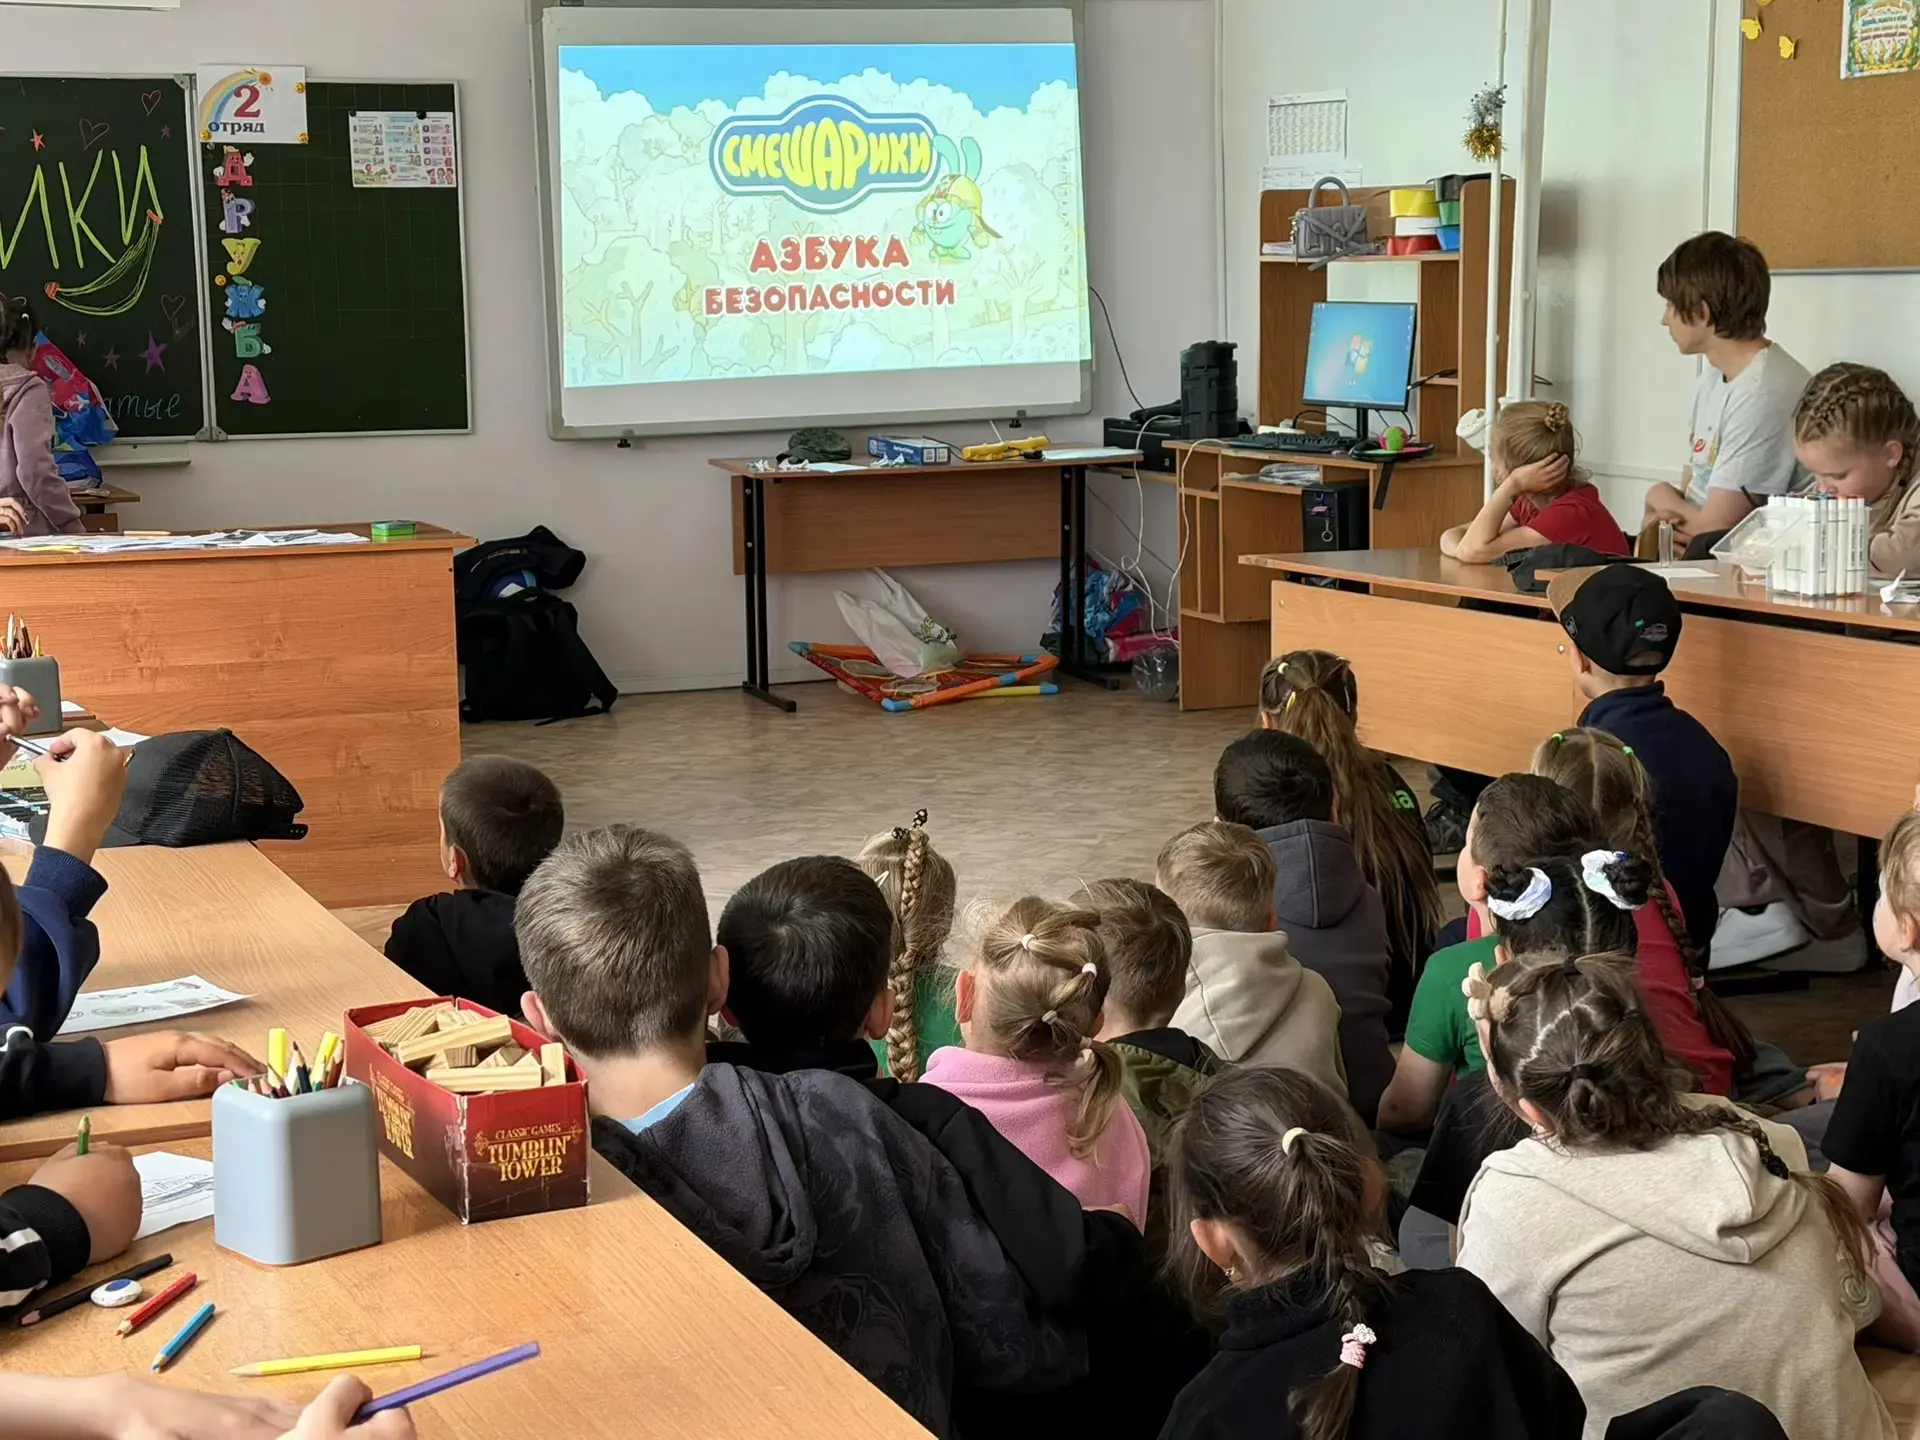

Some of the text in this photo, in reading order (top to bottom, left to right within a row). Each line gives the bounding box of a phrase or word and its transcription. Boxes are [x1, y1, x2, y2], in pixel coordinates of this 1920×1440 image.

[233, 84, 261, 118] 2
[208, 121, 266, 136] отряд
[722, 117, 931, 191] СМЕШАРИКИ
[749, 233, 911, 274] АЗБУКА
[703, 278, 956, 316] БЕЗОПАСНОСТИ
[495, 1122, 562, 1140] CLASSIC GAMES
[488, 1135, 571, 1165] TUMBLIN'
[499, 1155, 563, 1182] TOWER
